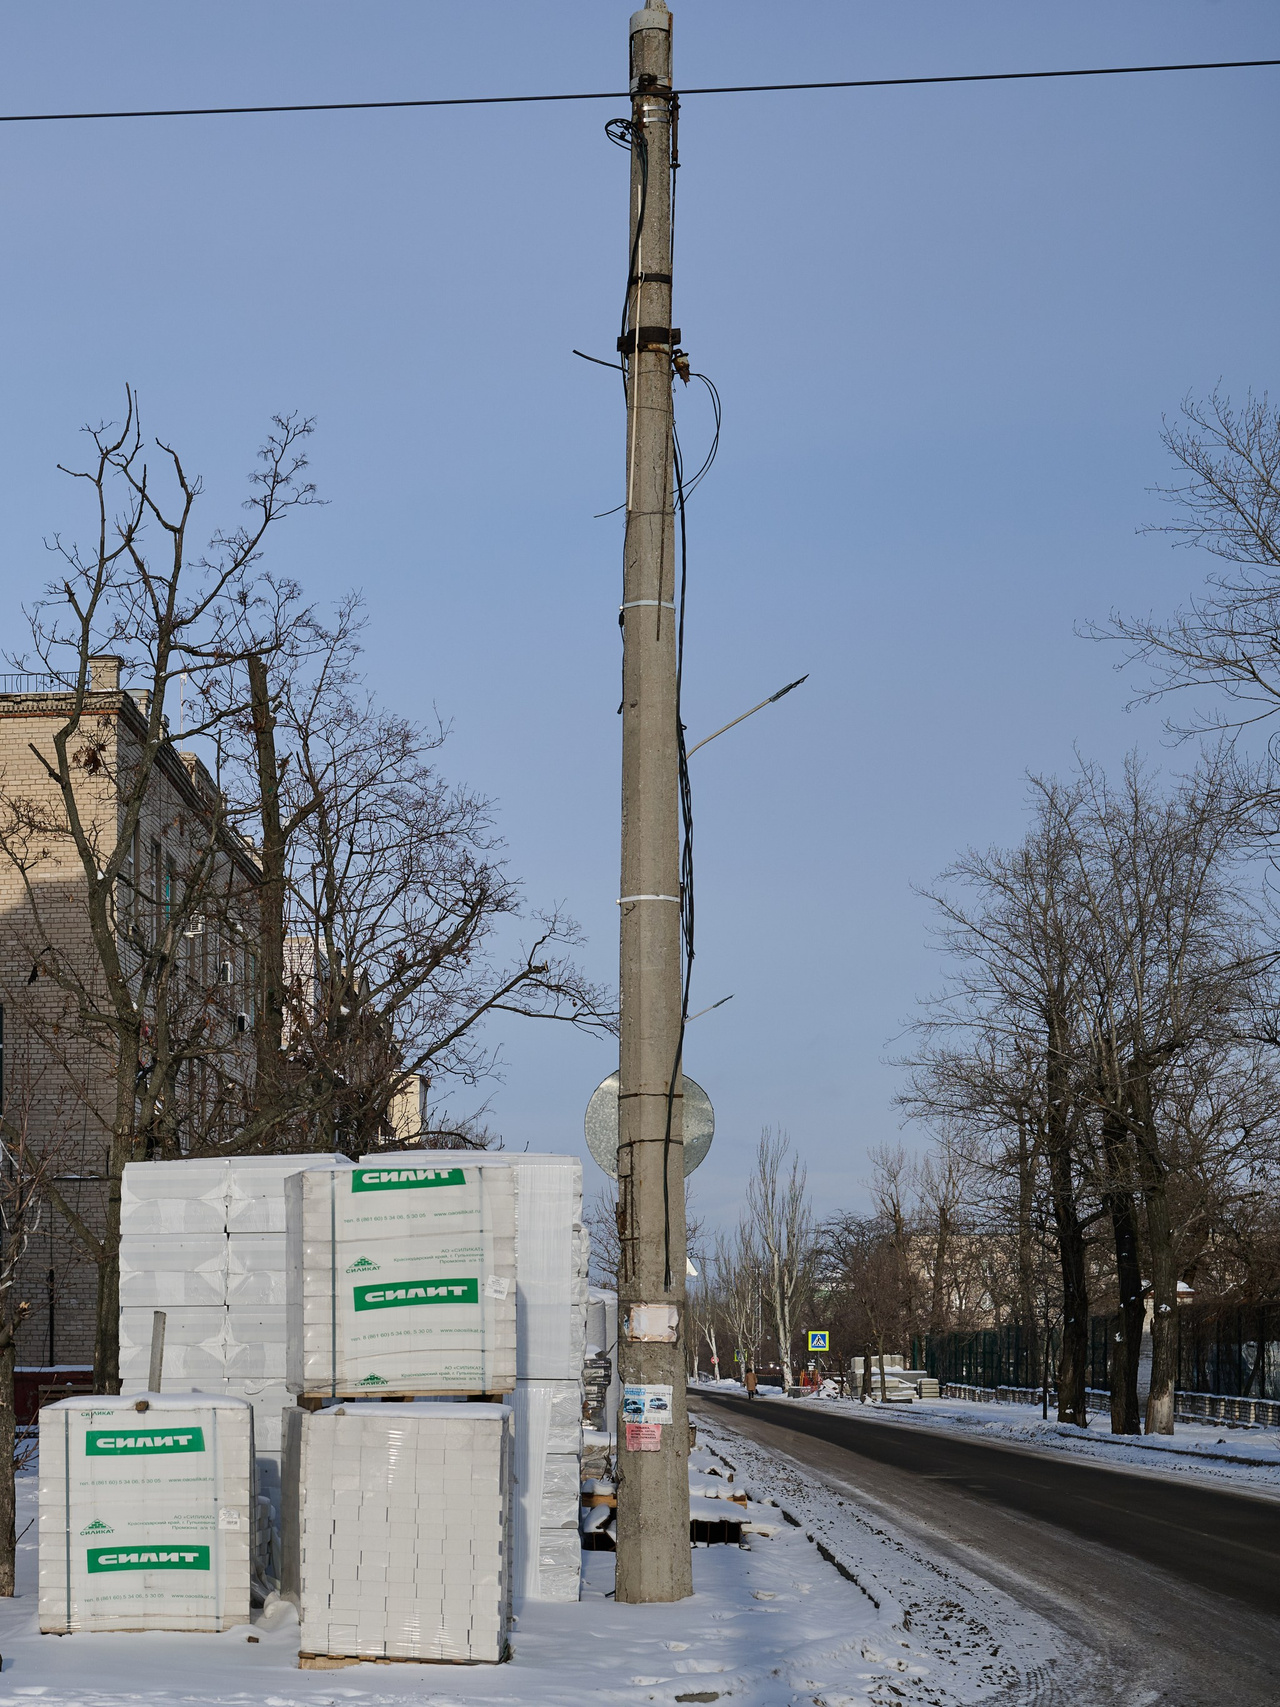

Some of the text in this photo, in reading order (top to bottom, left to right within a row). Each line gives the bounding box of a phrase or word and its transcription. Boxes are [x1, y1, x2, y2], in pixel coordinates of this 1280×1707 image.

[362, 1169, 453, 1184] СИЛИТ
[346, 1266, 381, 1274] СИЛИКАТ
[365, 1286, 468, 1302] СИЛИТ
[96, 1435, 192, 1448] СИЛИТ
[98, 1552, 199, 1565] СИЛИТ
